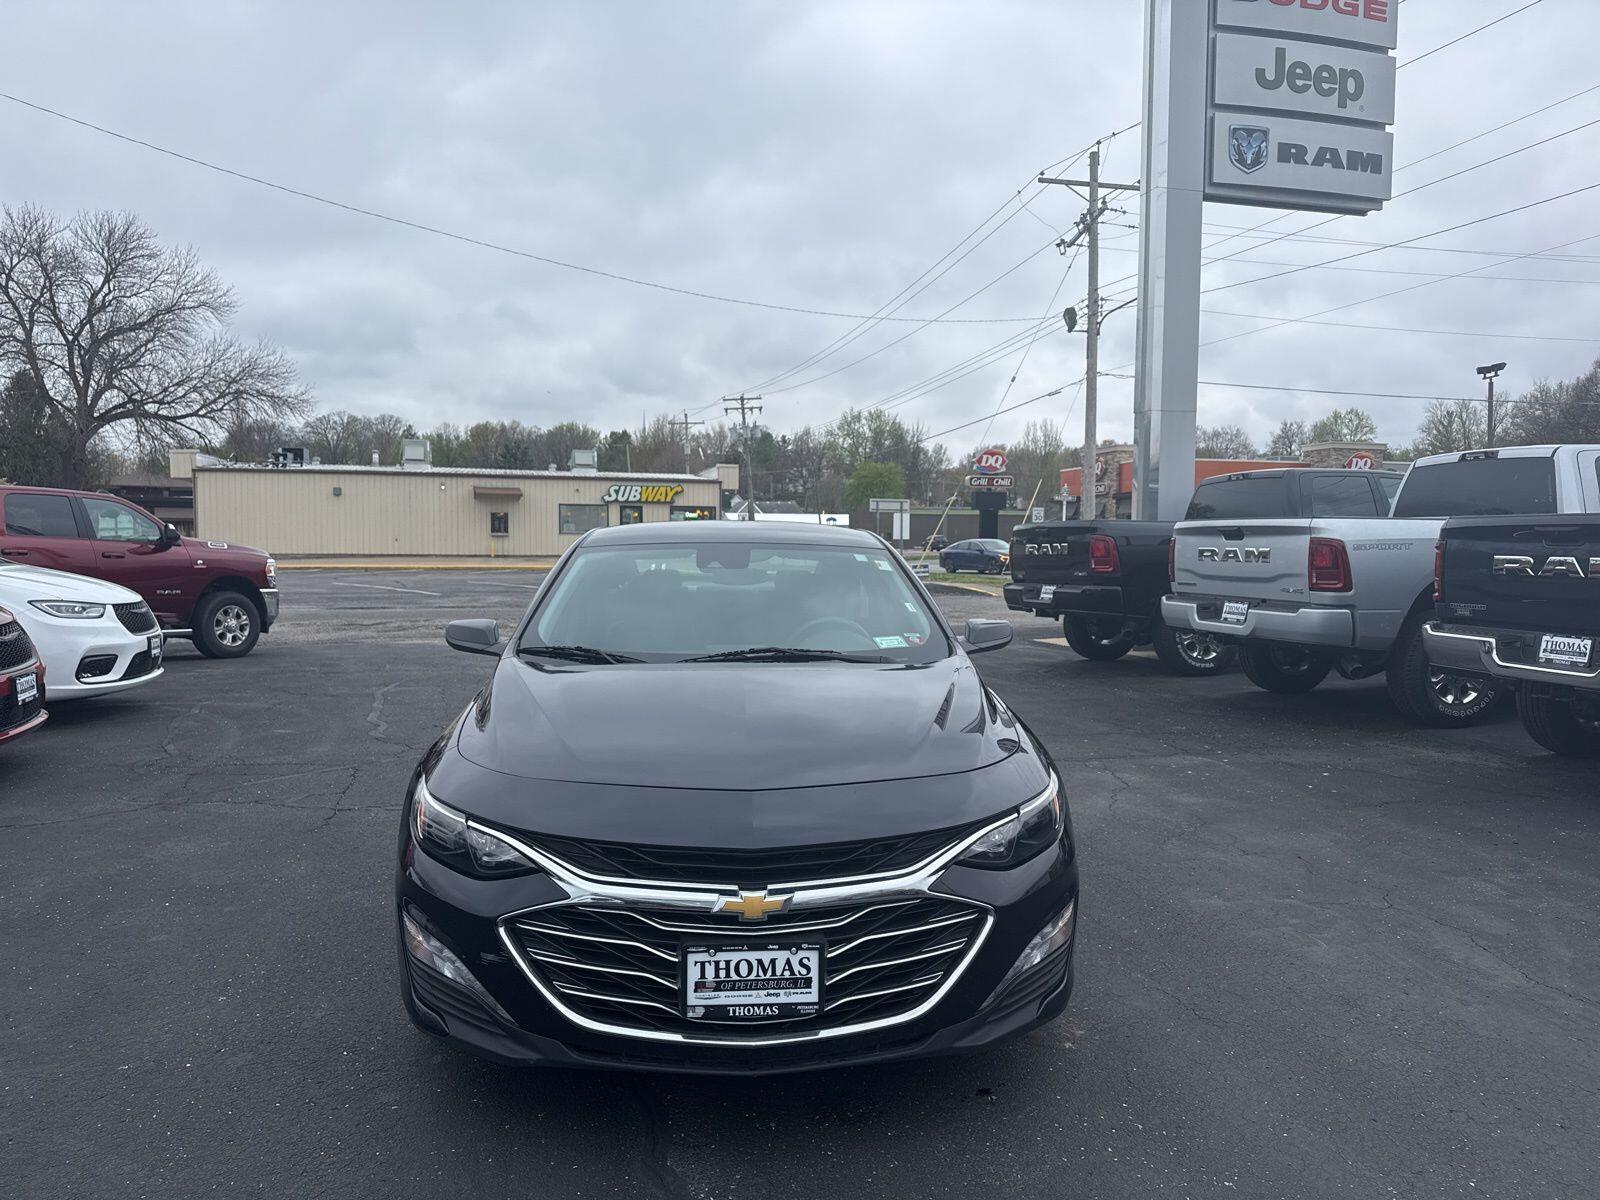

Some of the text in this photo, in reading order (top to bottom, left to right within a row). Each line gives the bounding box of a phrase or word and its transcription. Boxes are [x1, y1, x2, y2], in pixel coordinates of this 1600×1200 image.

[1255, 47, 1365, 108] Jeep
[1277, 142, 1383, 174] RAM
[981, 454, 1003, 469] DQ
[971, 478, 1011, 486] Grill Chill
[603, 484, 684, 502] SUBWAY
[1025, 543, 1068, 555] RAM
[1352, 543, 1414, 551] SPORT
[1198, 547, 1271, 563] RAM
[1544, 640, 1588, 652] THOMAS
[694, 957, 812, 980] THOMAS
[720, 979, 807, 990] OF PETERSBURG, IL
[727, 1005, 779, 1017] THOMAS
